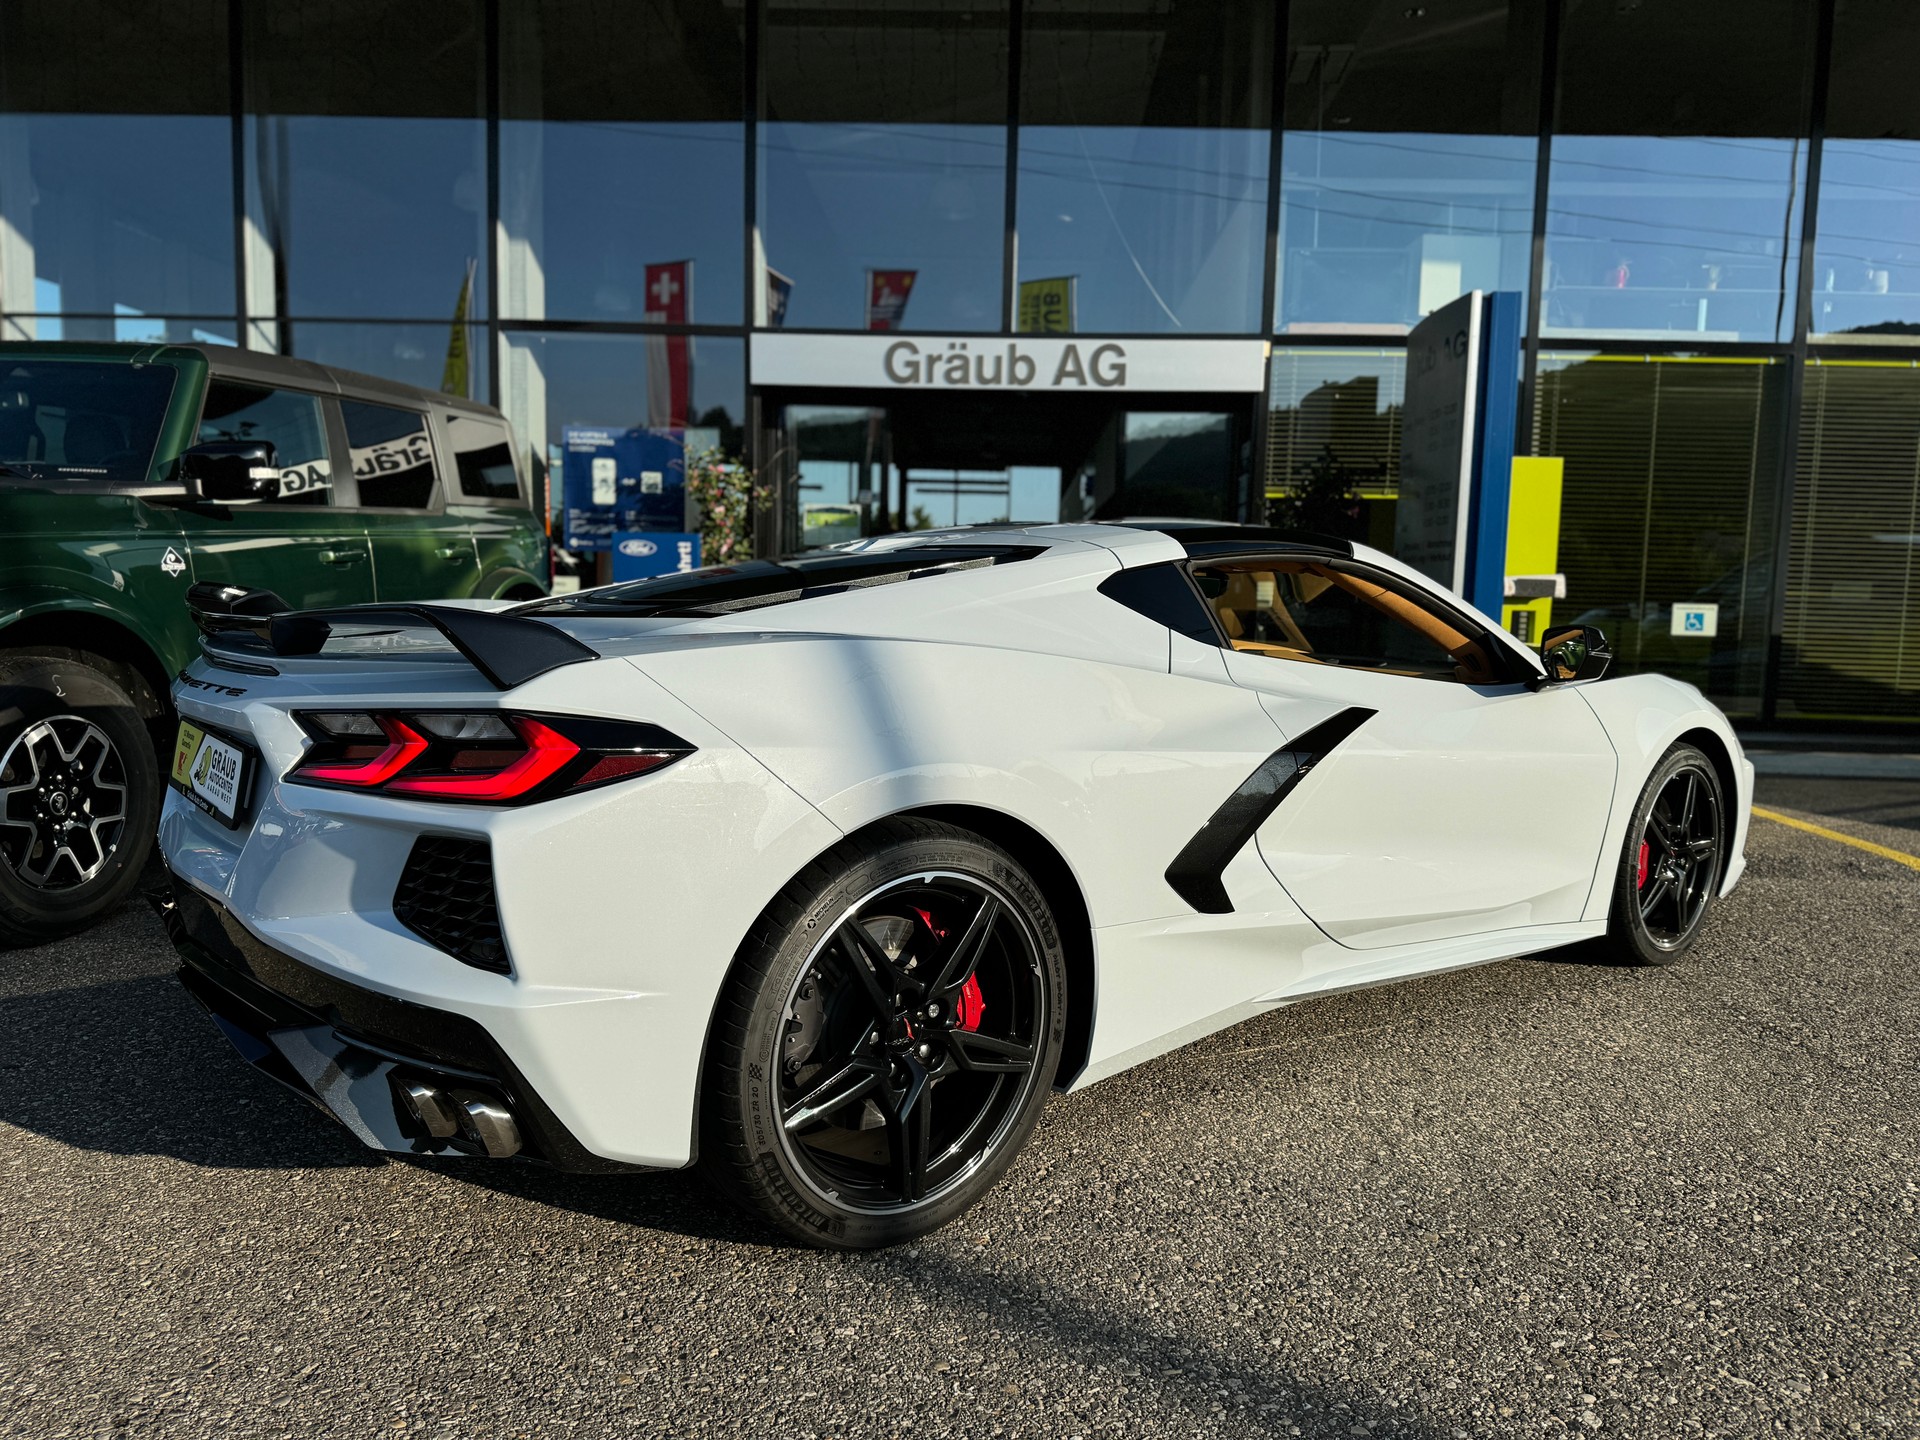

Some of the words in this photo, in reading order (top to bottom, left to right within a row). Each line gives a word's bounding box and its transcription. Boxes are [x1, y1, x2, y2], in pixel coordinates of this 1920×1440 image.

[883, 340, 1036, 386] Gräub
[1052, 343, 1128, 387] AG
[211, 749, 237, 780] GRÄUB
[208, 770, 233, 795] AUTOCENTER
[221, 792, 232, 805] WEST
[814, 896, 834, 918] MICHELIN
[1009, 874, 1054, 946] MICHELIN
[752, 1086, 760, 1098] 20
[752, 1099, 760, 1112] ZR
[753, 1111, 766, 1146] 305/30
[762, 1156, 828, 1228] MICHELIN
